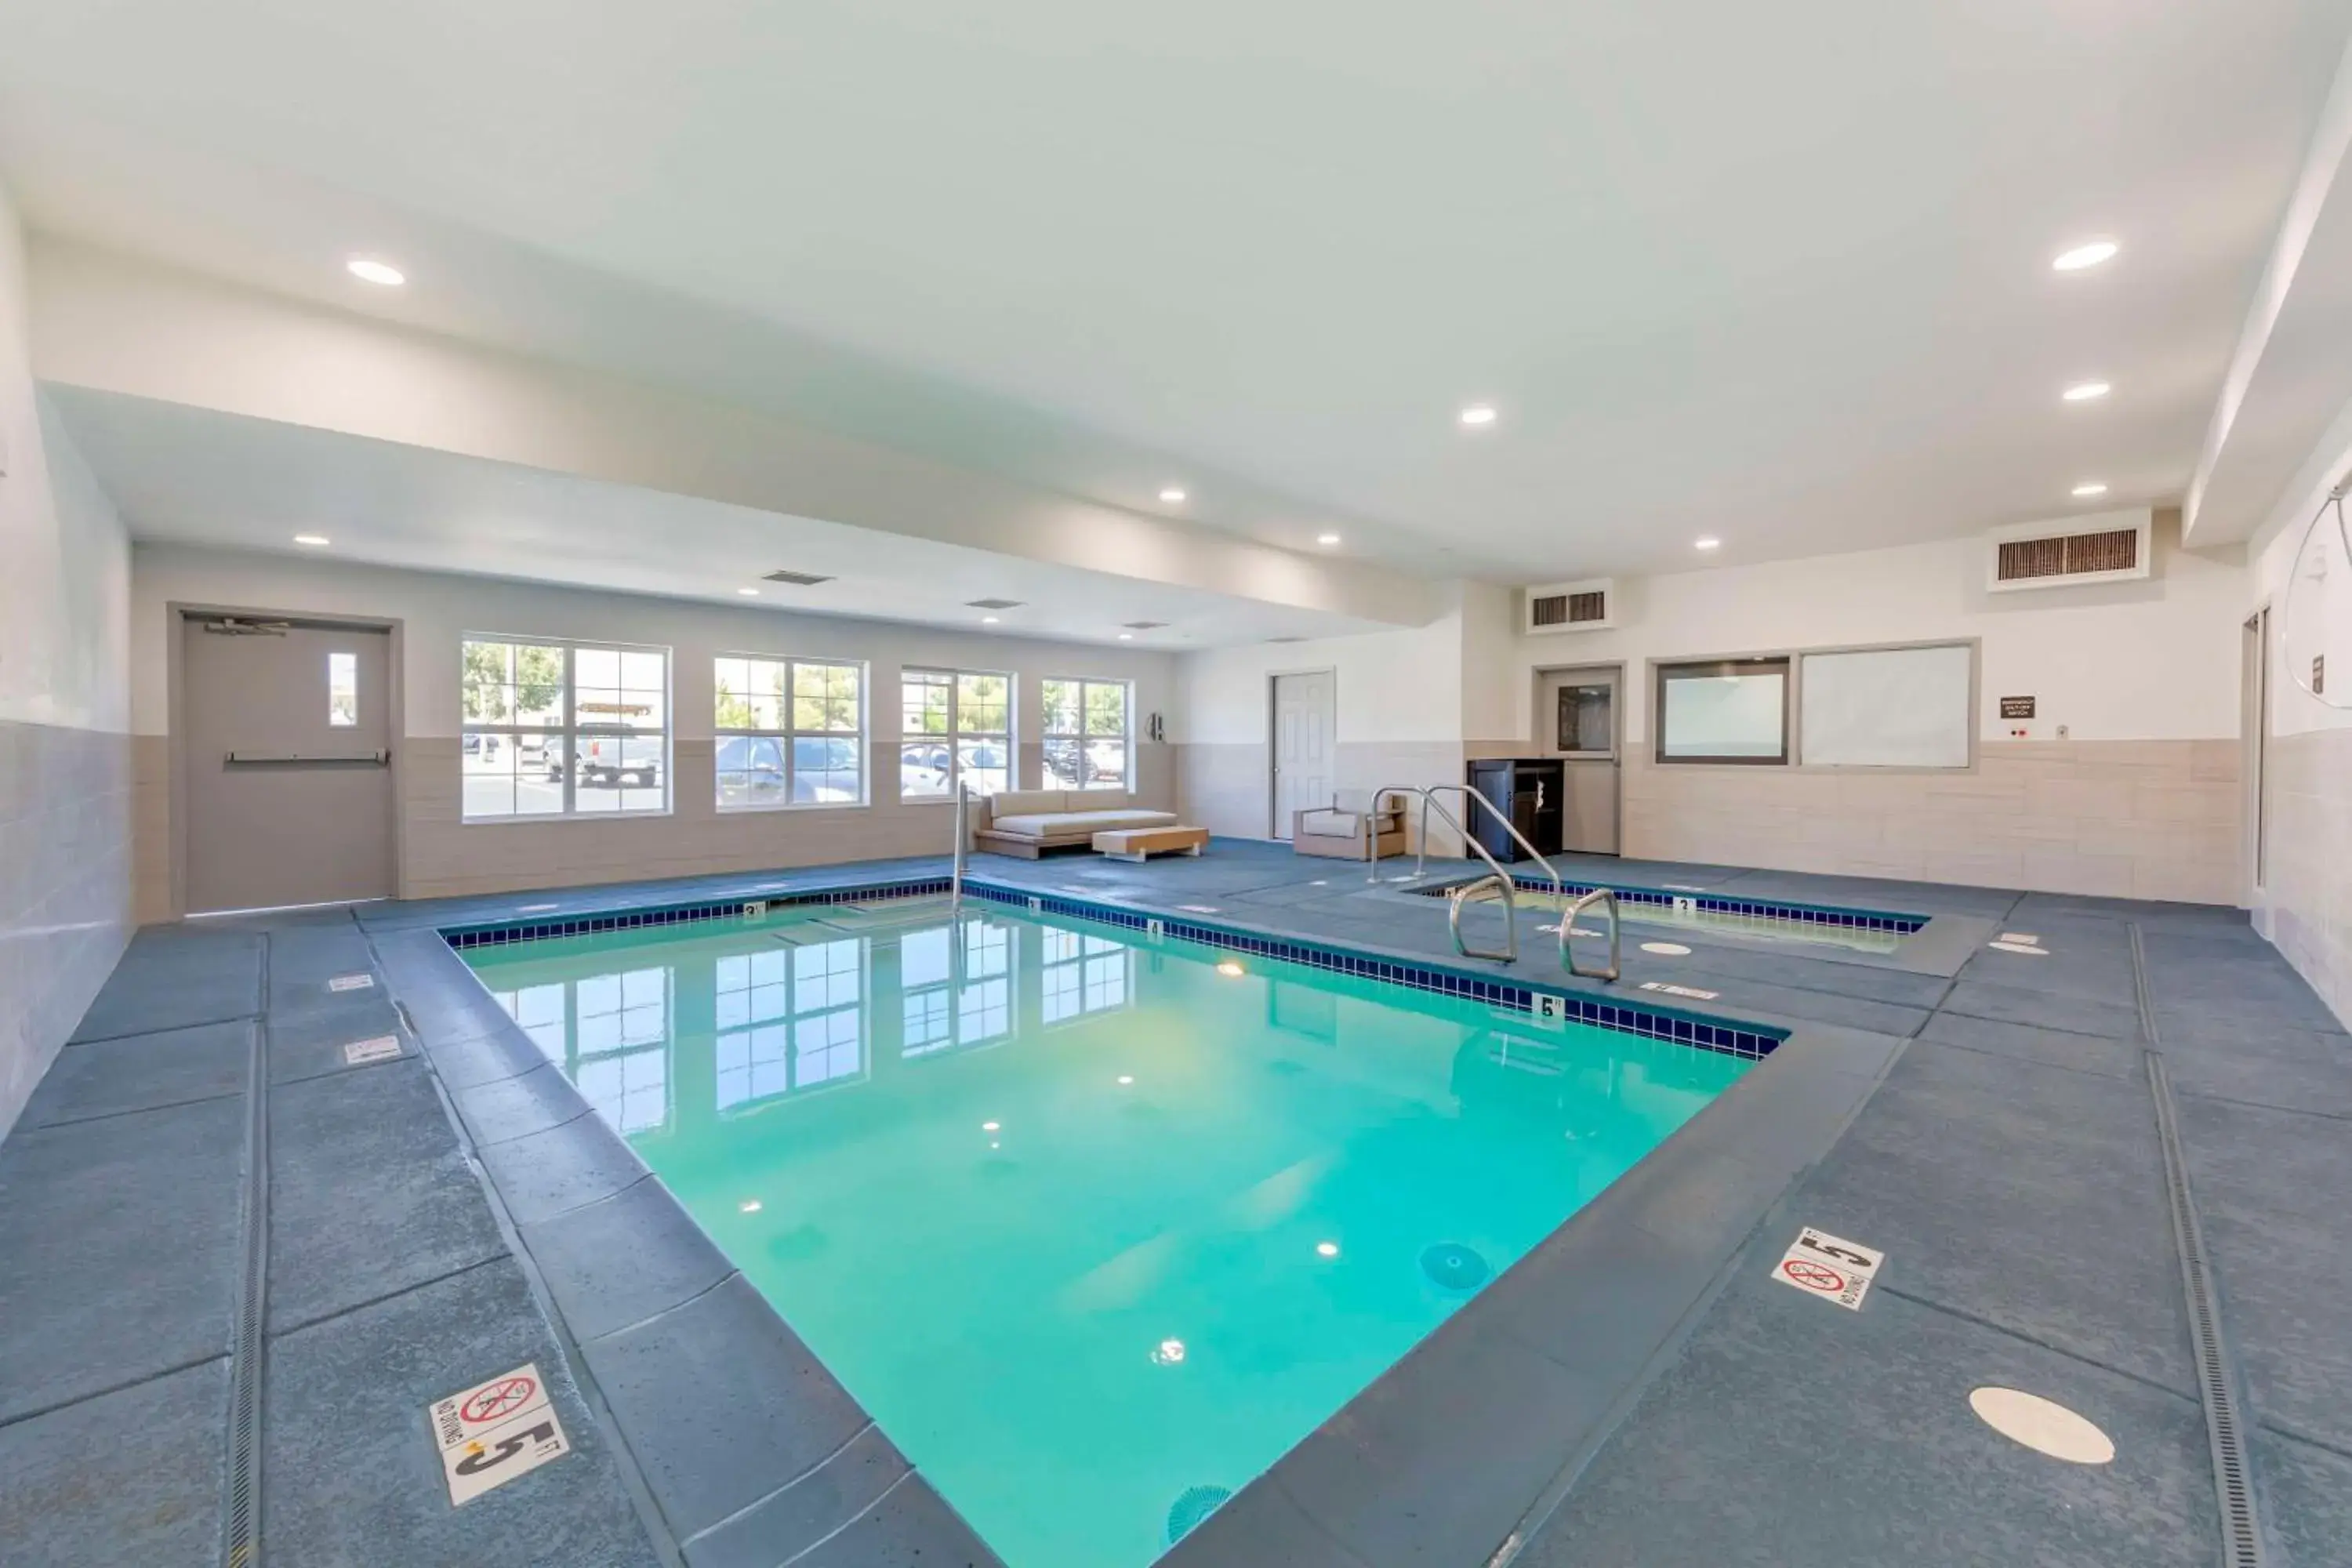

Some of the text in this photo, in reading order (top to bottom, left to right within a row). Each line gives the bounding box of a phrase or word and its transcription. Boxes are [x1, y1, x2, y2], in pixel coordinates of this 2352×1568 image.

[1542, 996, 1553, 1017] 5
[1799, 1236, 1872, 1268] 5
[437, 1399, 464, 1445] NO DIVING
[455, 1421, 555, 1476] 5
